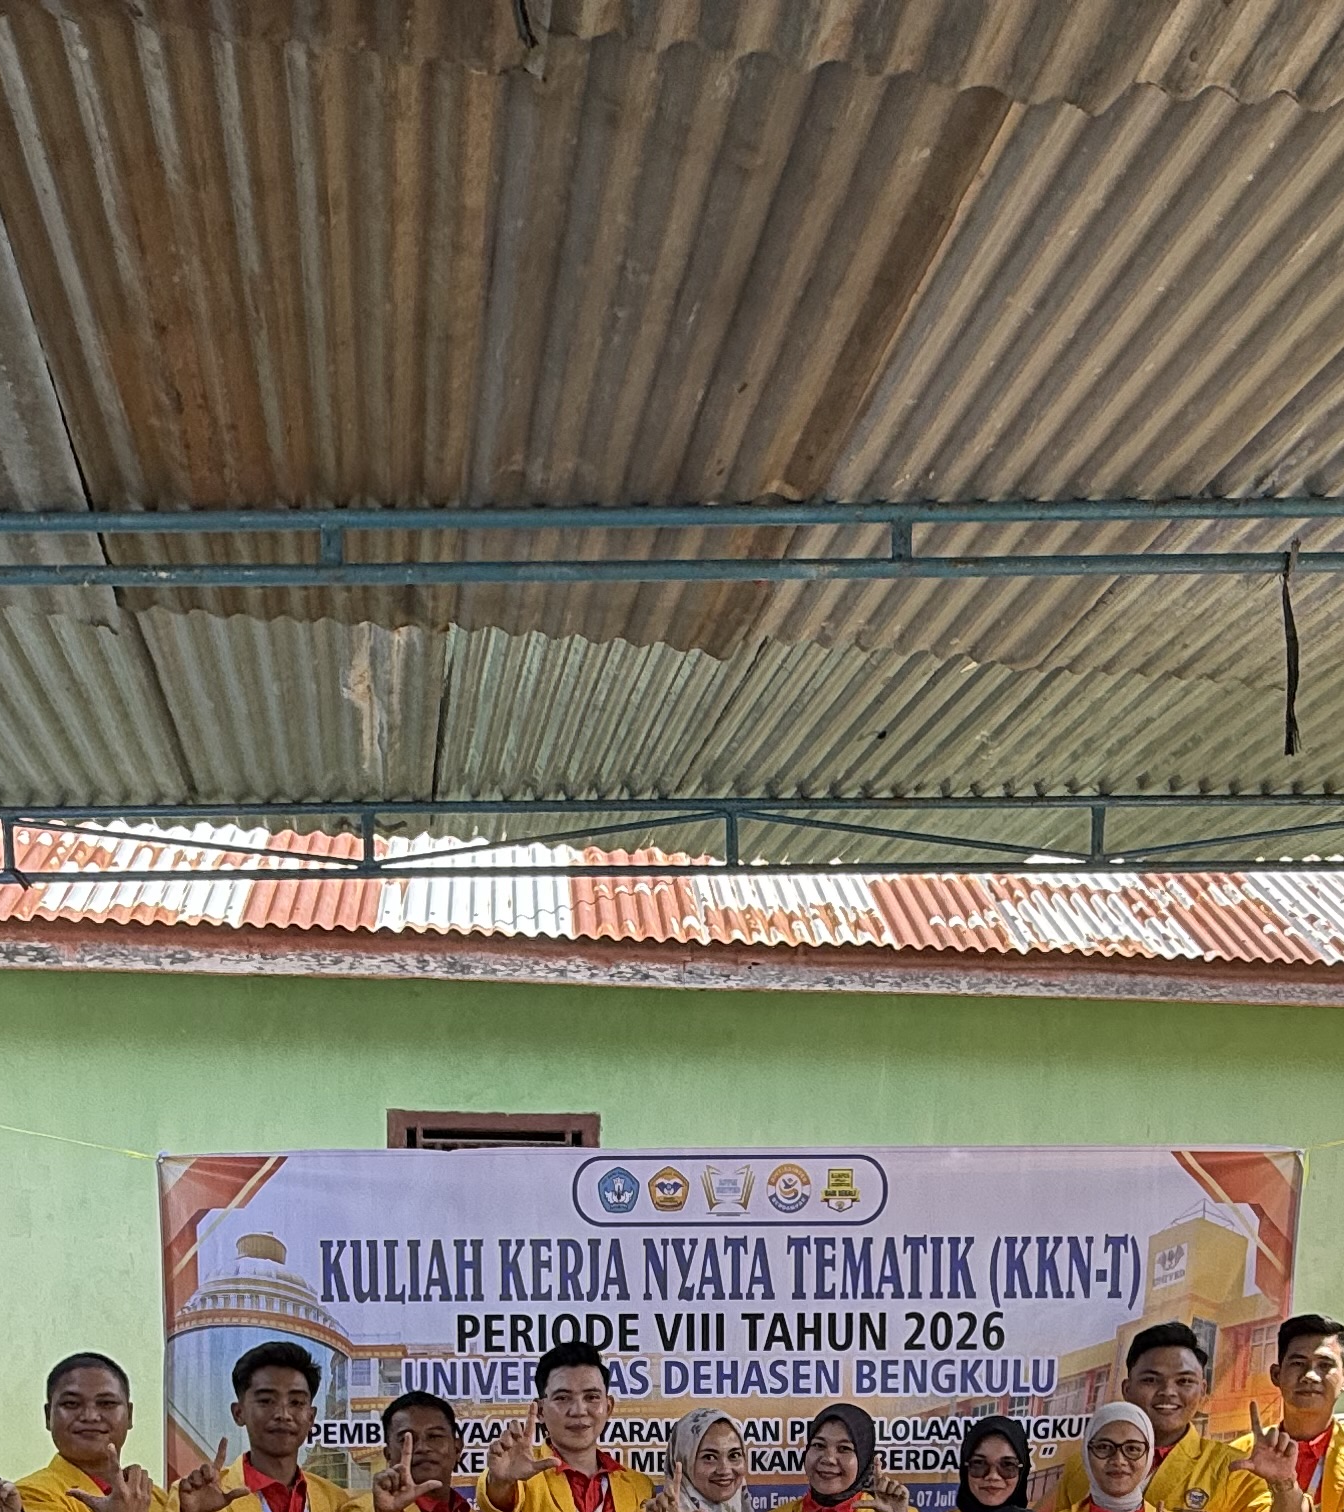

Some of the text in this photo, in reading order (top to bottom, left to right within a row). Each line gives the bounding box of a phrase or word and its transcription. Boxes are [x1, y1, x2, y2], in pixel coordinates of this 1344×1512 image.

[320, 1234, 1141, 1310] KULIAH KERJA NYATA TEMATIK (KKN-T)
[457, 1311, 1005, 1353] PERIODE VIII TAHUN 2026
[405, 1359, 1055, 1395] UNIVERAS DEHASEN BENGKULU
[916, 1490, 933, 1507] 07
[934, 1489, 956, 1507] Juli
